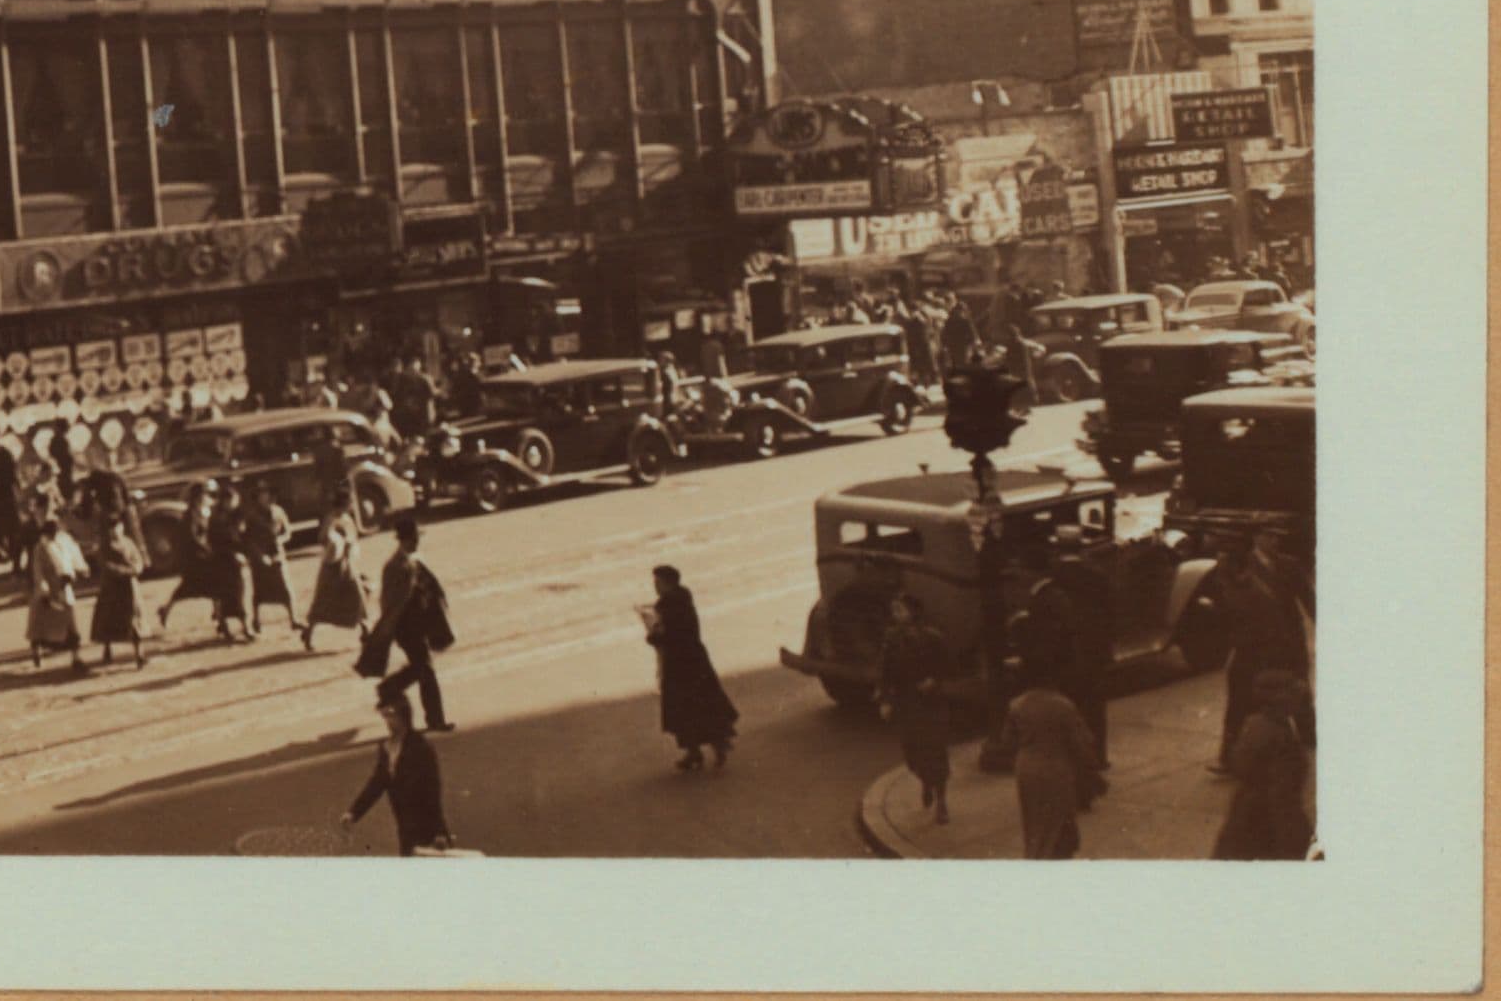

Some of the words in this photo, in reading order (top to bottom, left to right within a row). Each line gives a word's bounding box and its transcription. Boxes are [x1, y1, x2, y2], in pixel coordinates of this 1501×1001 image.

[1181, 106, 1255, 124] RETAIL
[1193, 122, 1250, 138] SHOP
[1180, 169, 1218, 189] SHOP
[1023, 211, 1073, 238] CARS
[84, 241, 235, 287] DRUGS
